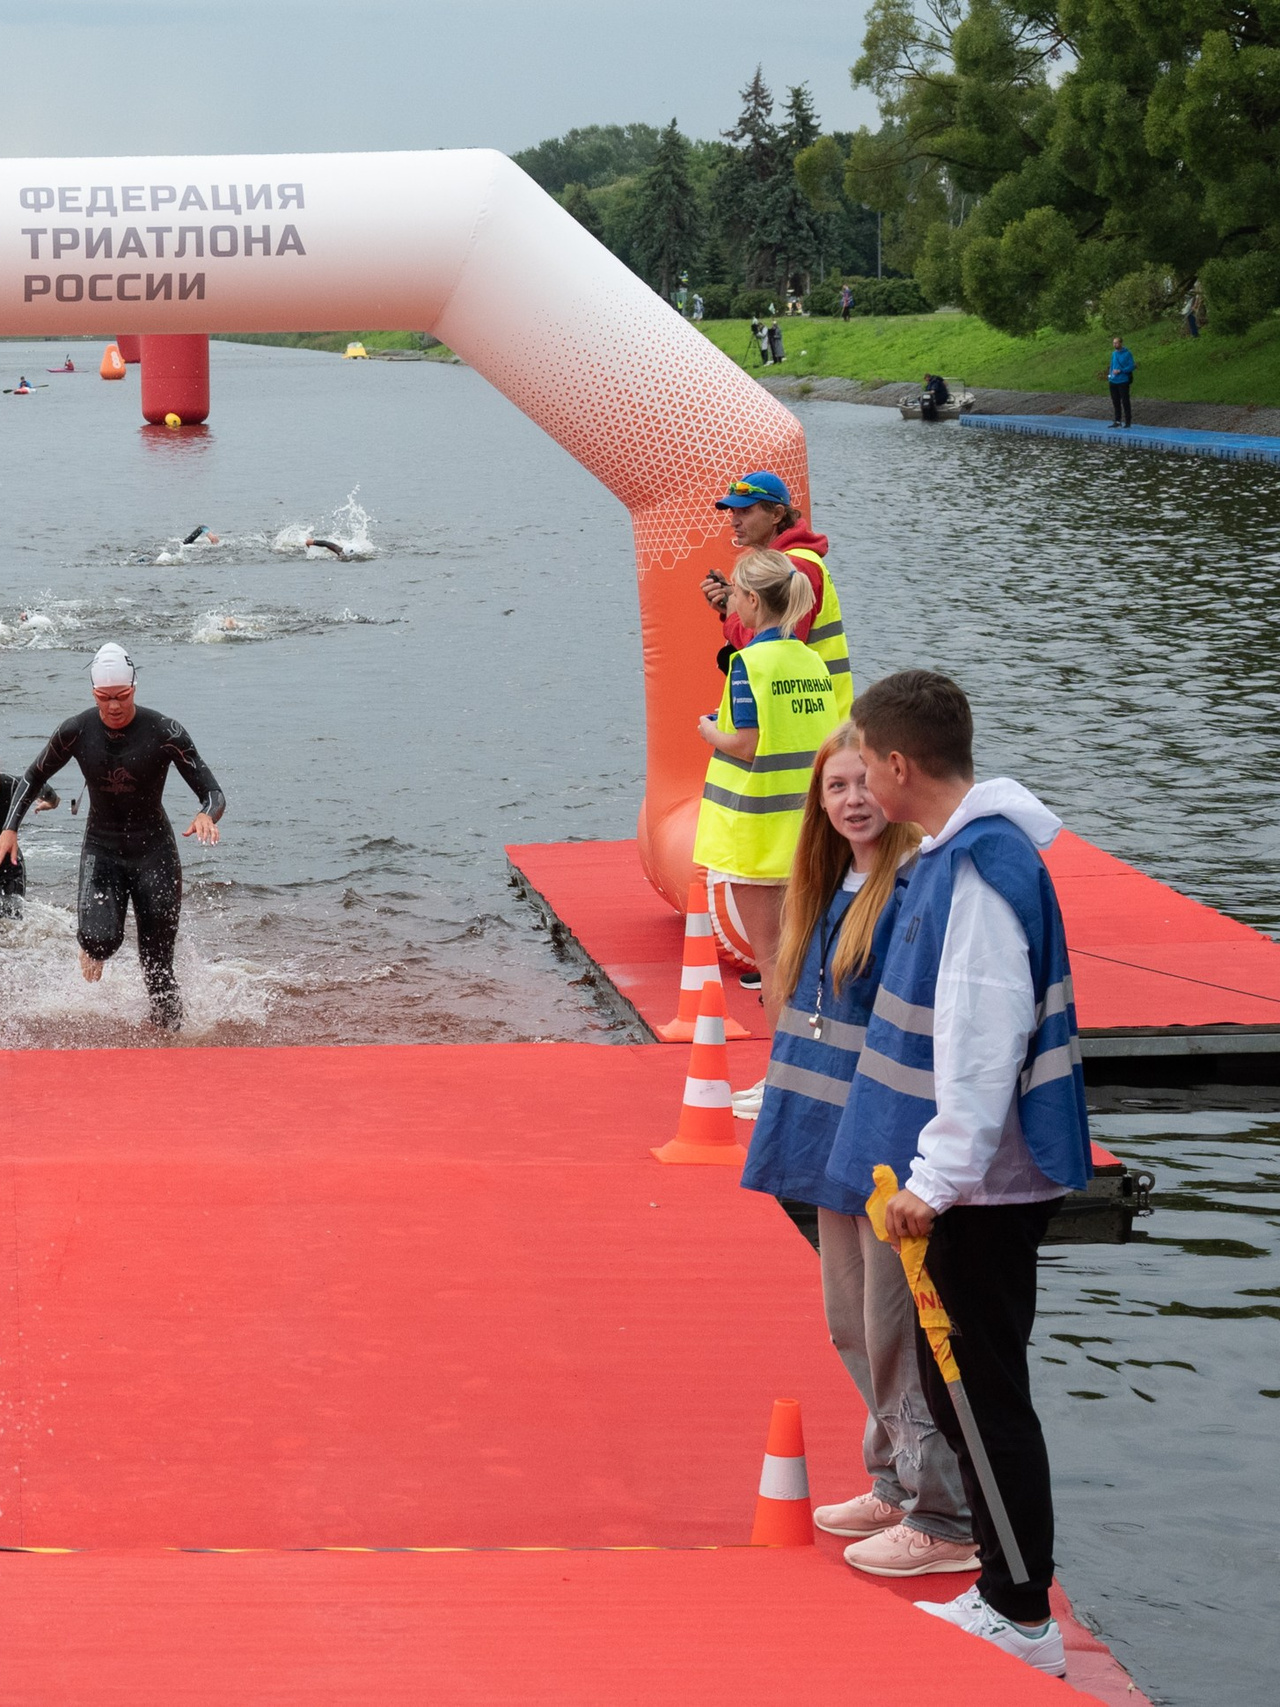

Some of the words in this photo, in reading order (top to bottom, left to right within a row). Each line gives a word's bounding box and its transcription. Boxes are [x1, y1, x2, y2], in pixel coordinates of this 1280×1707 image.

[19, 182, 306, 218] ФЕДЕРАЦИЯ
[21, 224, 307, 260] ТРИАТЛОНА
[23, 272, 207, 303] РОССИИ
[771, 675, 833, 696] СПОРТИВНЫЙ
[791, 697, 825, 714] СУДЬЯ
